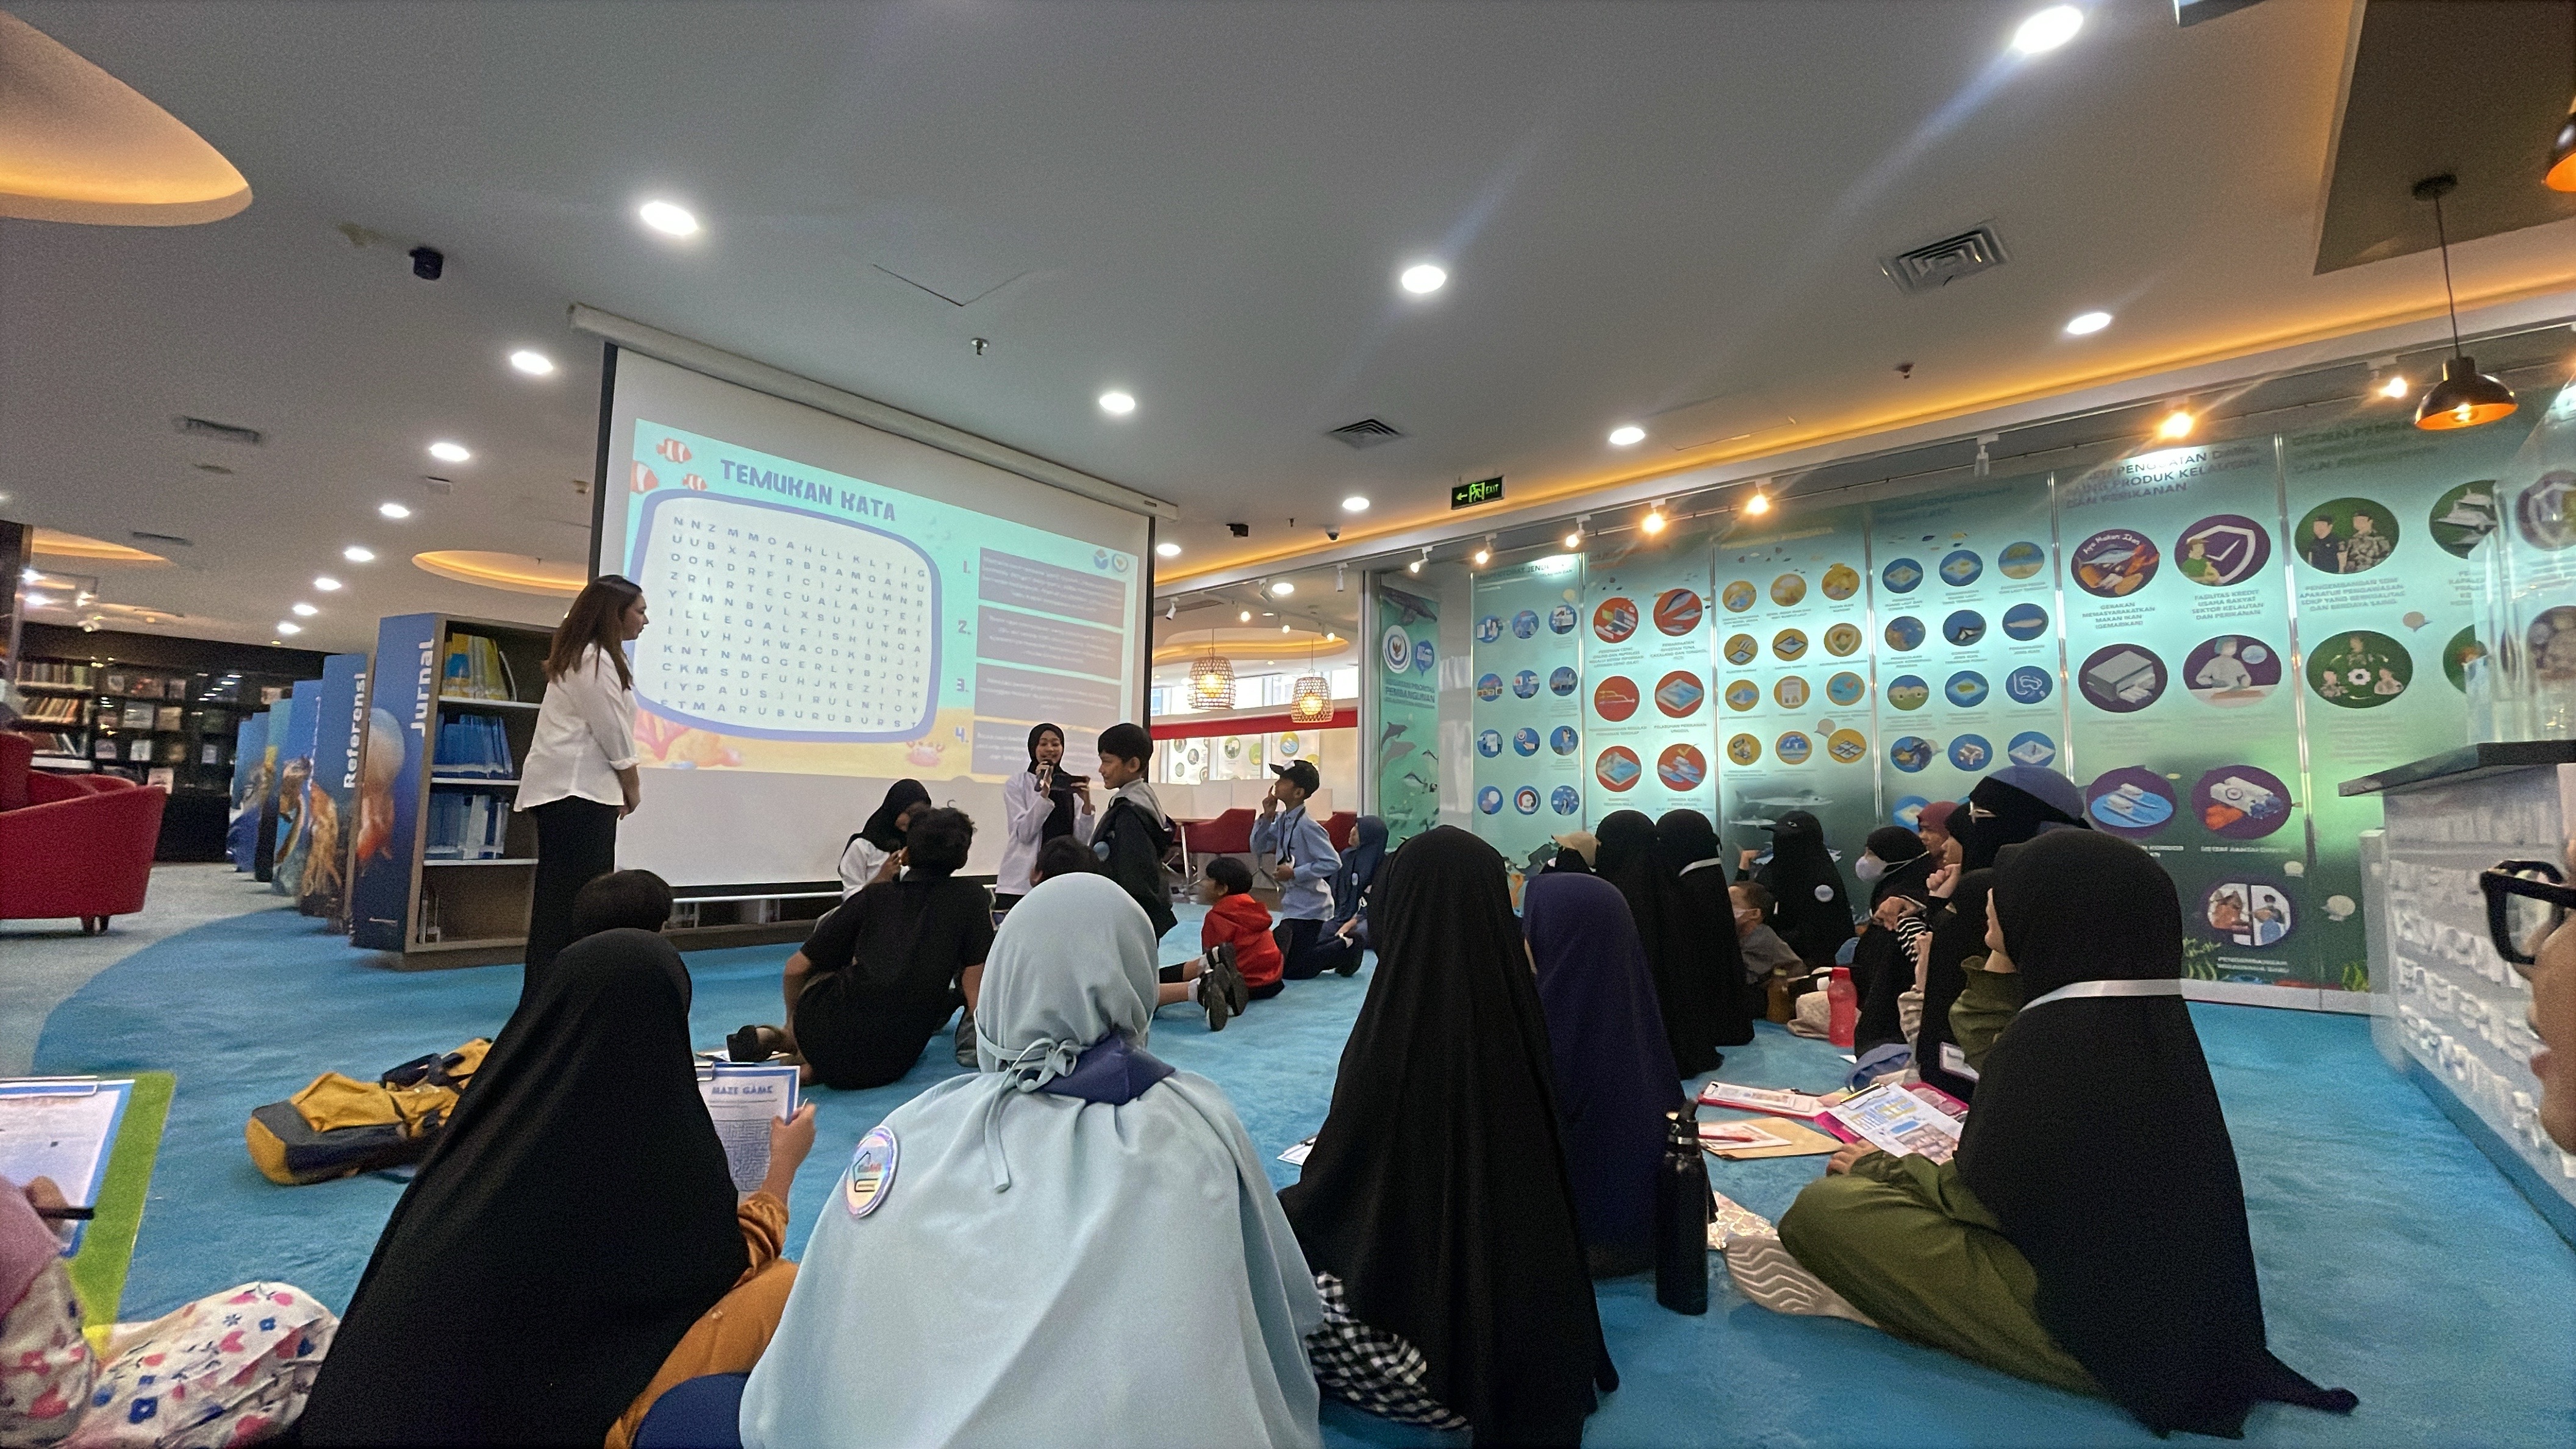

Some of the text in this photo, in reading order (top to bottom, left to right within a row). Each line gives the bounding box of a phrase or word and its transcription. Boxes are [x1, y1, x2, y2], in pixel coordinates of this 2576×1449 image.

[2113, 473, 2174, 487] PRODUK
[720, 459, 895, 521] TEMUKAN KATA
[1486, 484, 1498, 495] EXIT
[963, 560, 971, 574] 1.
[958, 620, 971, 635] 2.
[410, 639, 434, 737] Jurnal
[956, 678, 969, 692] 3.
[343, 673, 366, 789] Referensi
[956, 727, 969, 743] 4.
[711, 1085, 773, 1095] MAZE GAME
